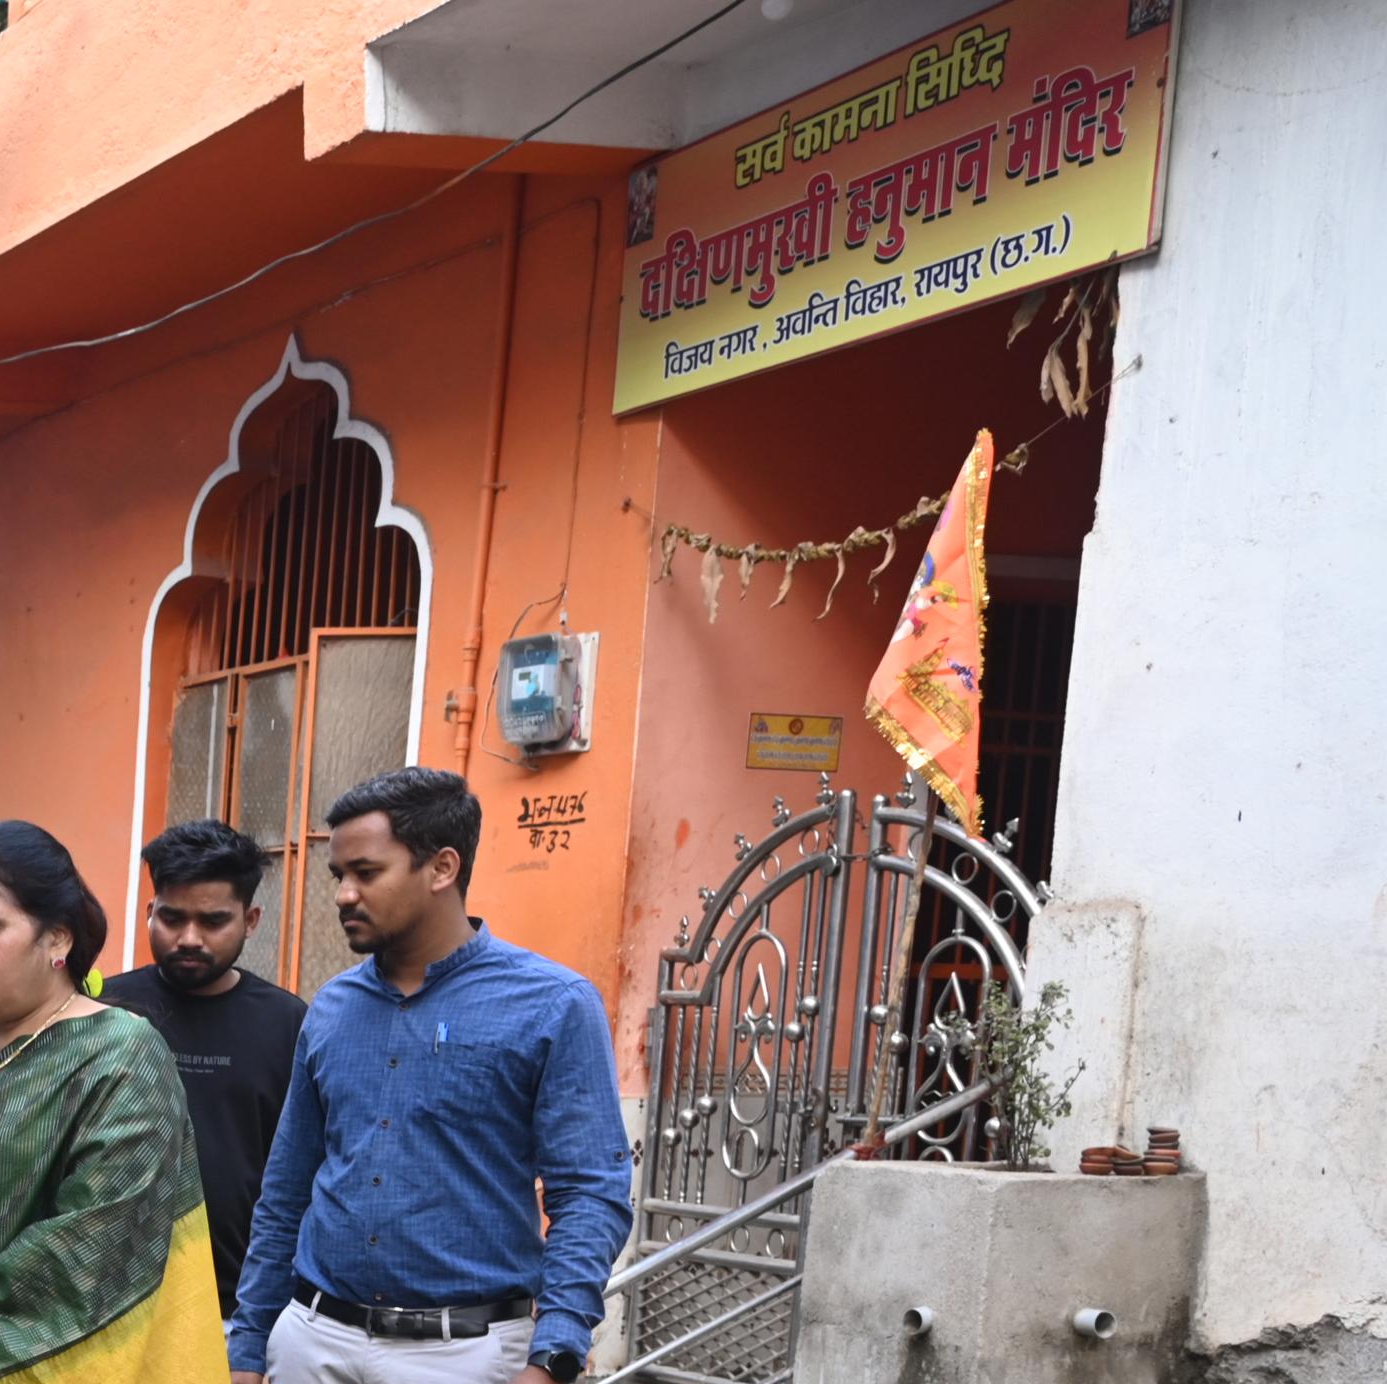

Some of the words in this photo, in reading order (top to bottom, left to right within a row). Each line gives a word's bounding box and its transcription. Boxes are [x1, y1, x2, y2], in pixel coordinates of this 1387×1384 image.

[639, 170, 839, 322] दक्षिणमुखी
[844, 121, 999, 265] हनुमान
[1005, 65, 1136, 187] मंदिर
[734, 110, 790, 190] सर्व
[792, 76, 903, 163] कामना
[664, 341, 715, 379] विजय
[773, 292, 840, 345] अवन्ति
[844, 279, 907, 321] विहार,
[914, 247, 985, 294] रायपुर
[192, 1055, 203, 1065] BY
[203, 1056, 231, 1066] NATURE
